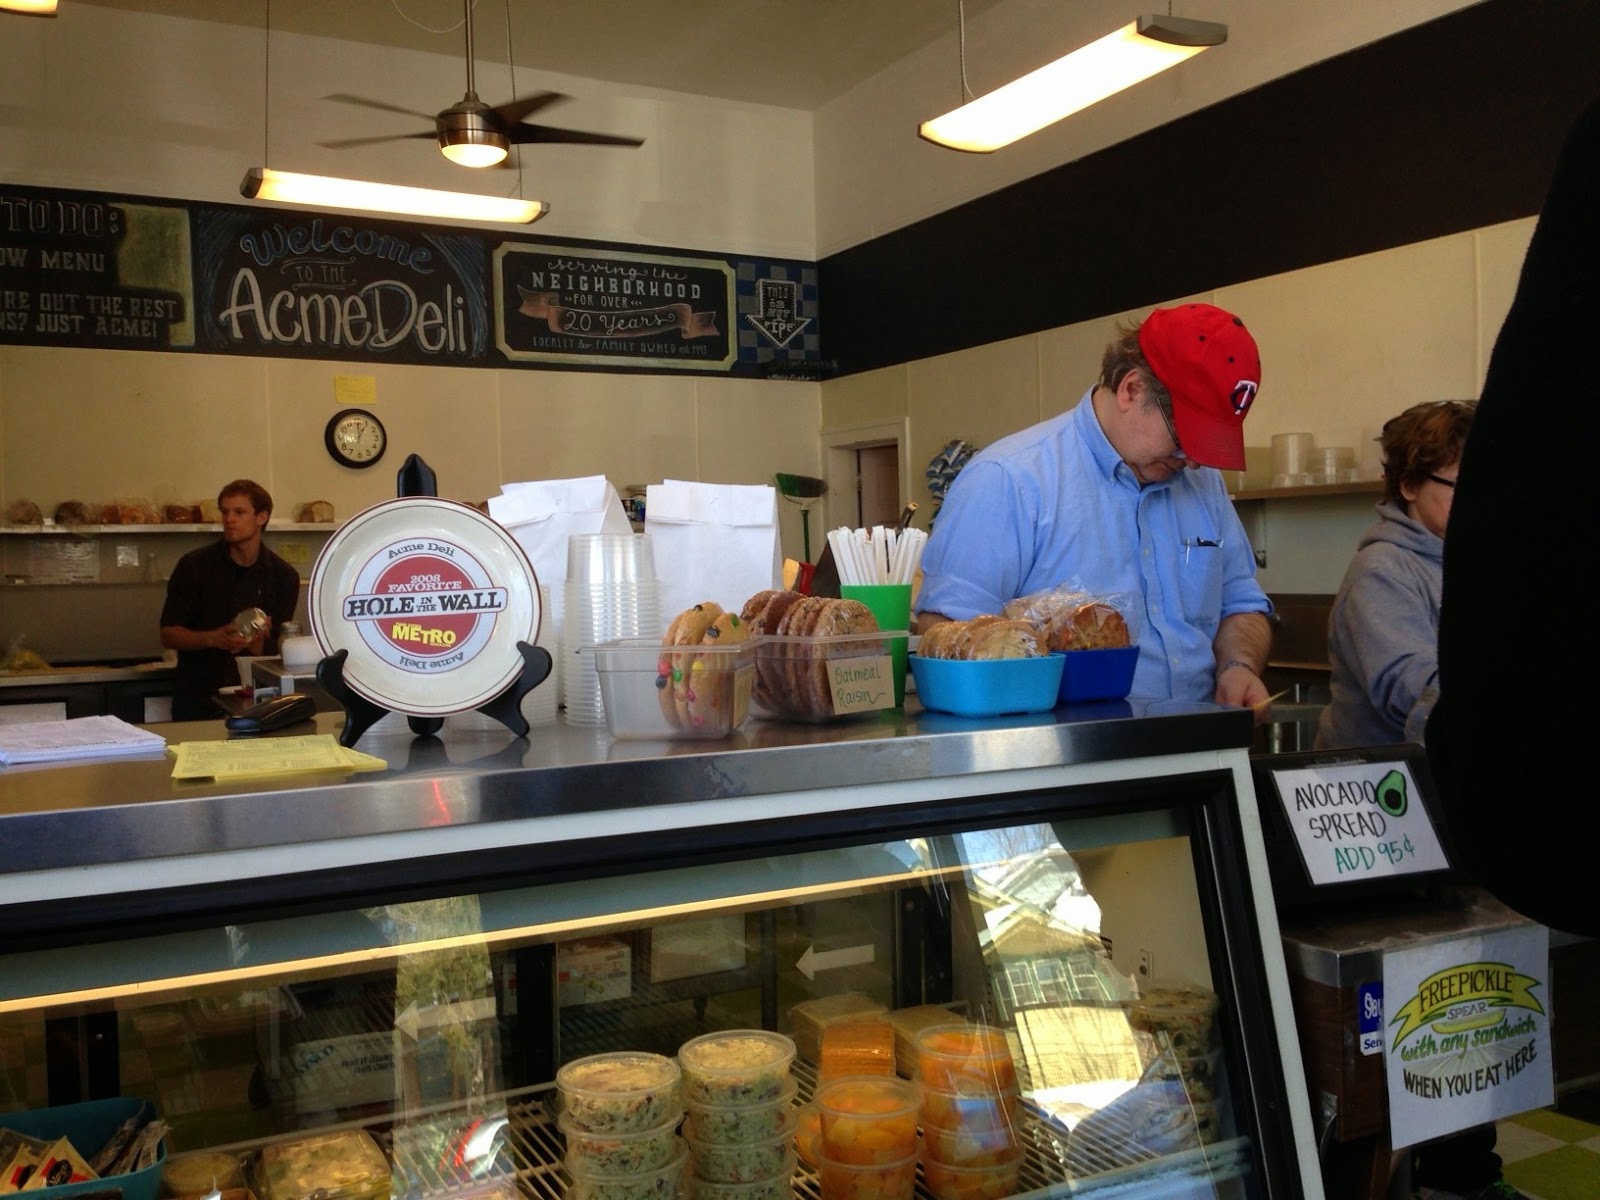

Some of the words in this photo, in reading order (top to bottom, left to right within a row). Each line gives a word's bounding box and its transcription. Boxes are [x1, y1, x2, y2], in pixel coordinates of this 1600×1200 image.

[1, 197, 50, 233] TO
[240, 218, 435, 274] Welcome
[41, 250, 105, 272] MENU
[547, 258, 649, 281] serving
[652, 267, 689, 281] the
[295, 265, 313, 282] TO
[320, 264, 346, 283] THE
[532, 271, 701, 299] NEIGHBORHOOD
[39, 293, 81, 313] OUT
[86, 295, 123, 315] THE
[130, 297, 177, 319] REST
[573, 294, 594, 306] FOR
[600, 295, 628, 309] OVER
[36, 312, 85, 335] JUST
[96, 315, 157, 338] ACME!
[563, 310, 592, 331] 20
[599, 313, 676, 336] Years
[764, 321, 796, 339] PIPE
[596, 340, 635, 351] FAMILY
[640, 342, 677, 354] OWNED
[388, 543, 425, 559] Acme
[427, 542, 456, 557] Deli
[387, 580, 462, 593] FAVORITE
[410, 574, 441, 585] 2008
[347, 596, 415, 617] HOLE
[416, 604, 437, 613] THE
[420, 596, 433, 605] IN
[438, 592, 502, 611] WALL
[392, 624, 457, 645] METRO
[399, 655, 428, 669] Deli
[834, 660, 881, 685] Oatmeal
[836, 687, 886, 708] Raisin
[1295, 780, 1377, 811] AVOCADO
[1309, 811, 1387, 842] SPREAD
[1334, 845, 1376, 874] ADD
[1447, 1001, 1487, 1020] SPEAR
[1401, 1033, 1439, 1062] with
[1439, 1033, 1469, 1060] any
[1471, 1013, 1537, 1048] sandwich
[1403, 1068, 1443, 1099] WHEN
[1444, 1072, 1473, 1098] YOU
[1474, 1062, 1502, 1092] EAT
[1505, 1038, 1538, 1081] HERE
